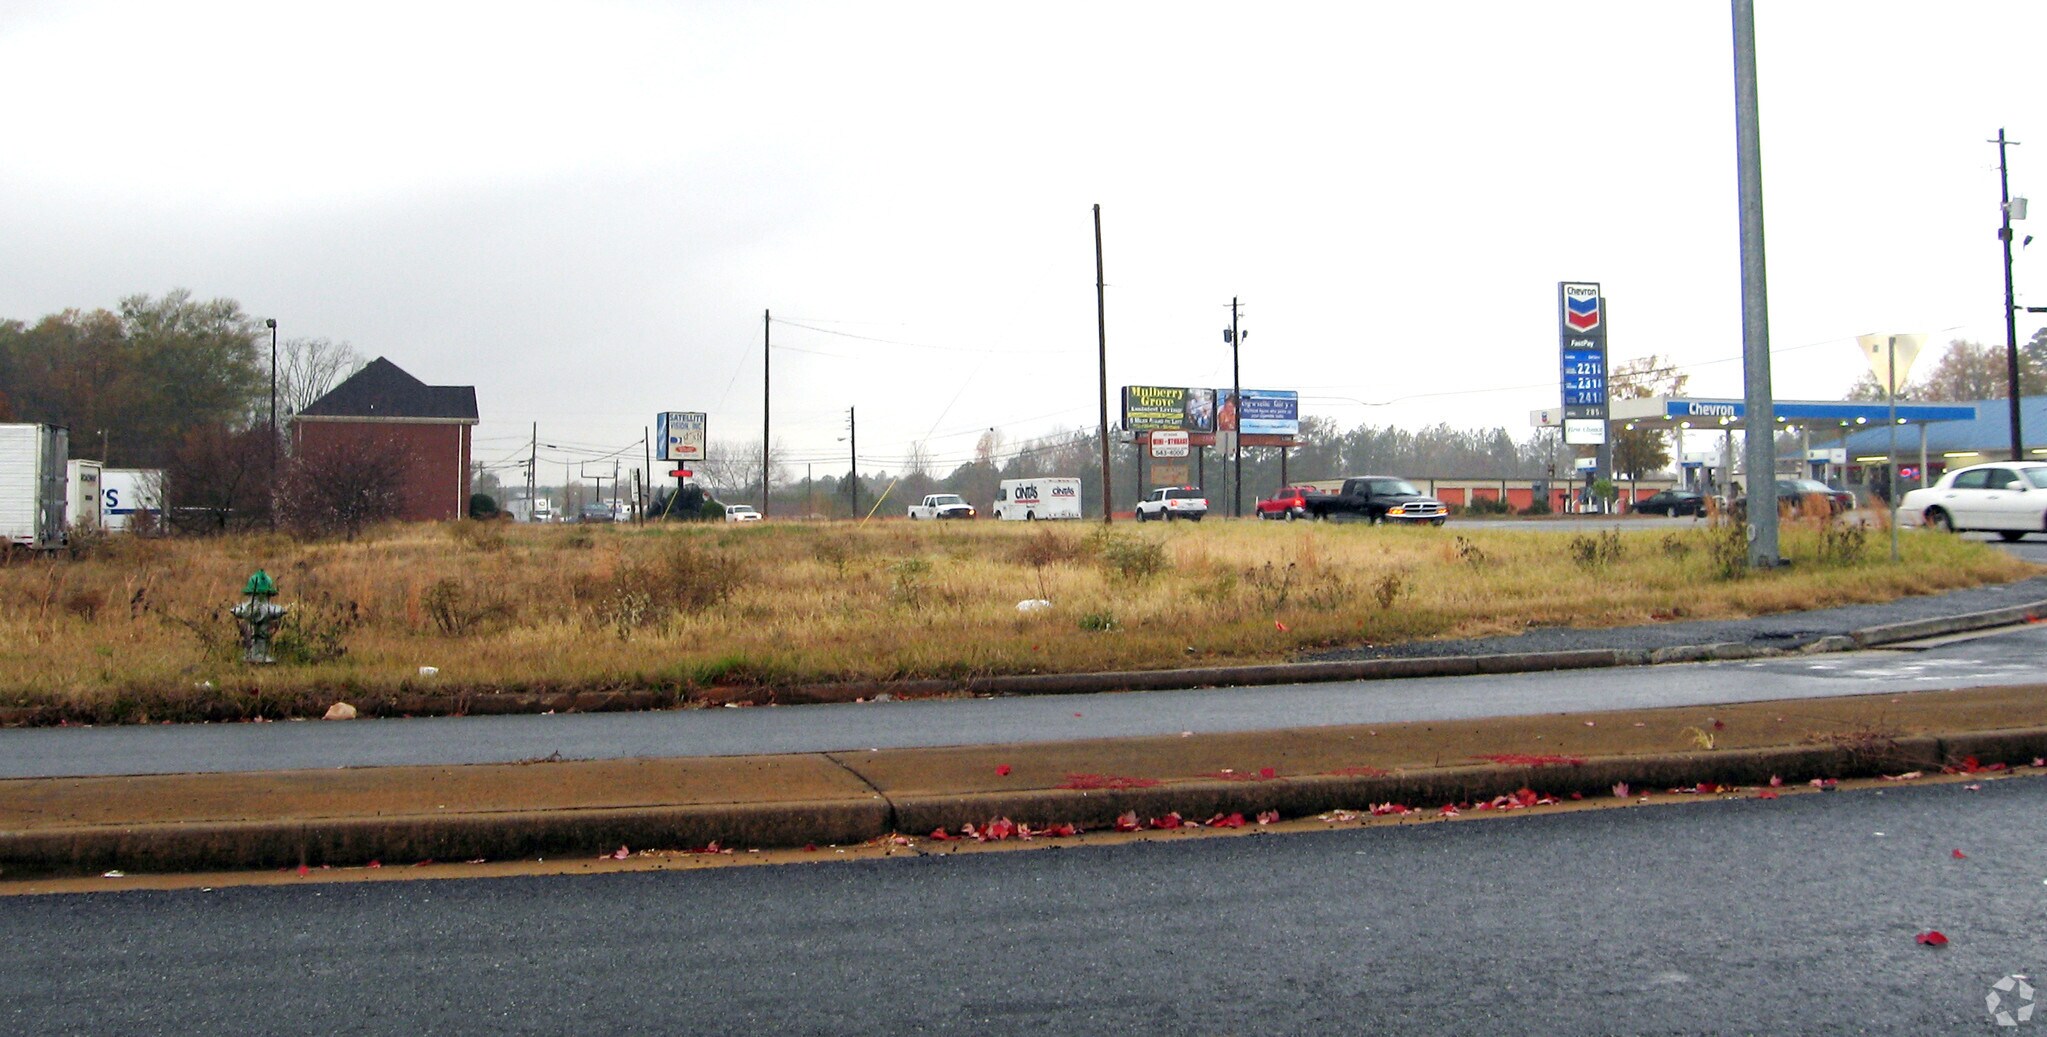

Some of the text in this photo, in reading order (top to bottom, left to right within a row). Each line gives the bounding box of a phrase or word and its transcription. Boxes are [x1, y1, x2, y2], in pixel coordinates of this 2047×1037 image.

[1567, 286, 1597, 295] Chevron
[1131, 386, 1183, 399] Mulberry
[1140, 396, 1174, 406] Grove
[1688, 402, 1735, 416] Chevron
[670, 414, 704, 422] SATELLITE
[1015, 483, 1038, 499] CINTAS
[1051, 486, 1075, 495] CINTAS
